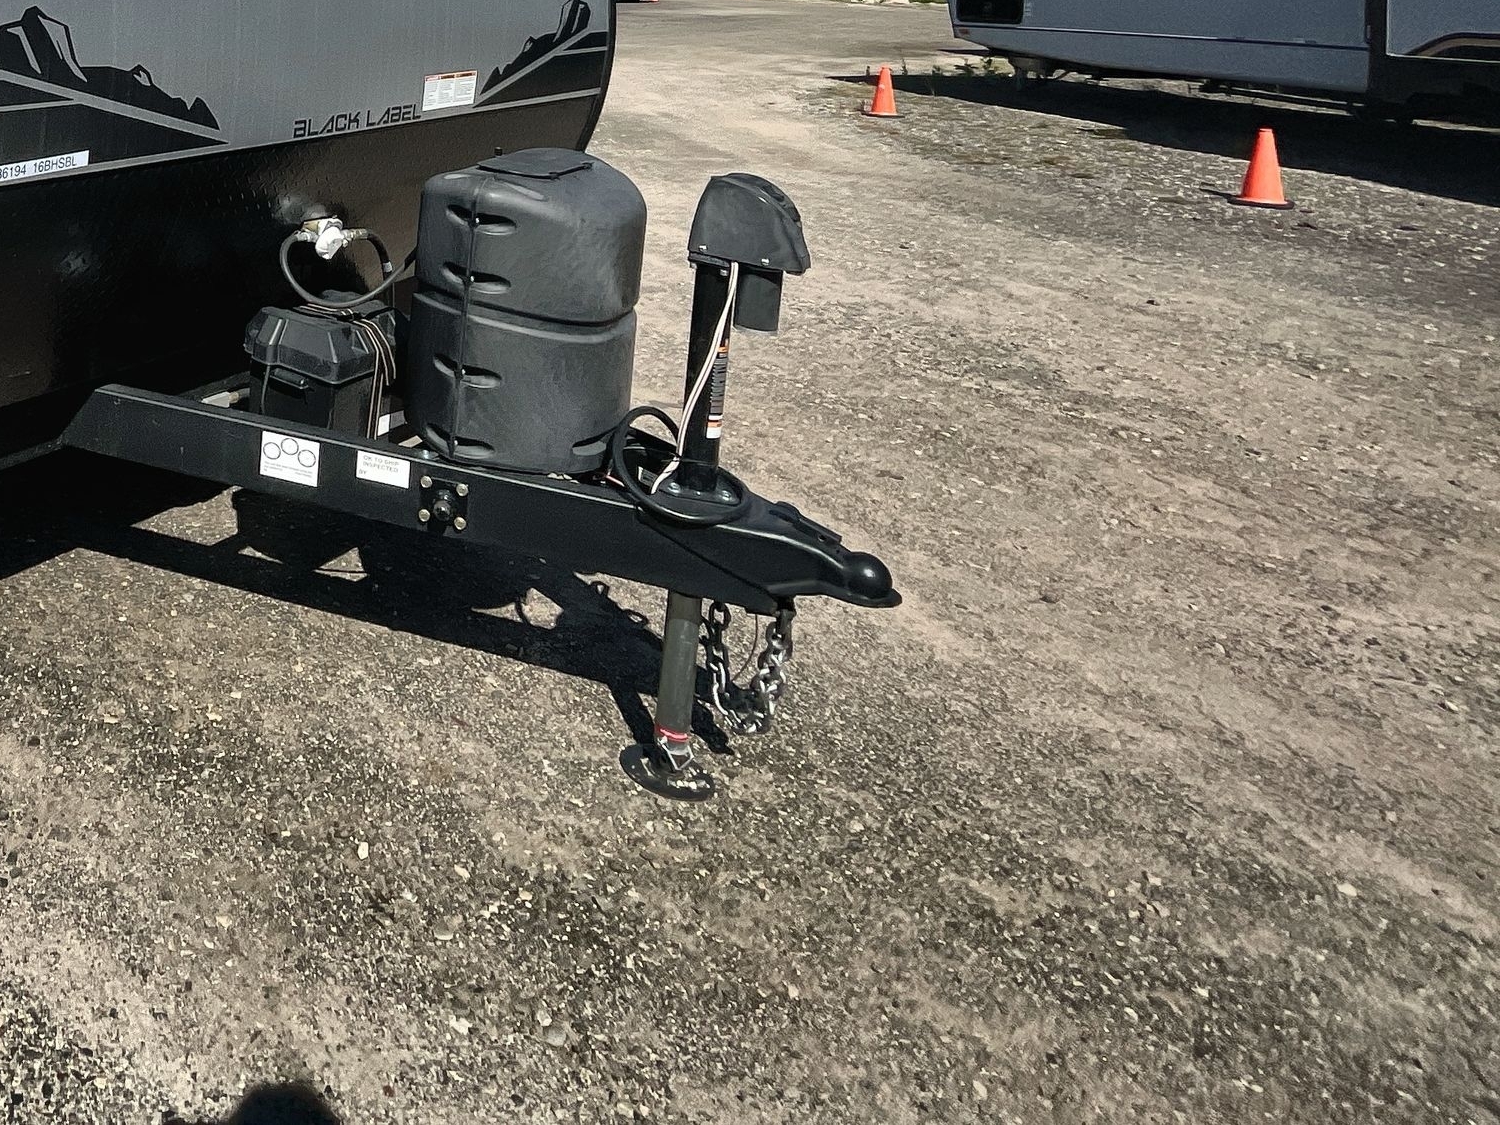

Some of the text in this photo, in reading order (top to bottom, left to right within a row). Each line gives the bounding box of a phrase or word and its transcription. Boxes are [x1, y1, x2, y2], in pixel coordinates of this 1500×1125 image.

[293, 104, 421, 139] BLACK LABEL
[33, 156, 77, 173] 16BHSBL
